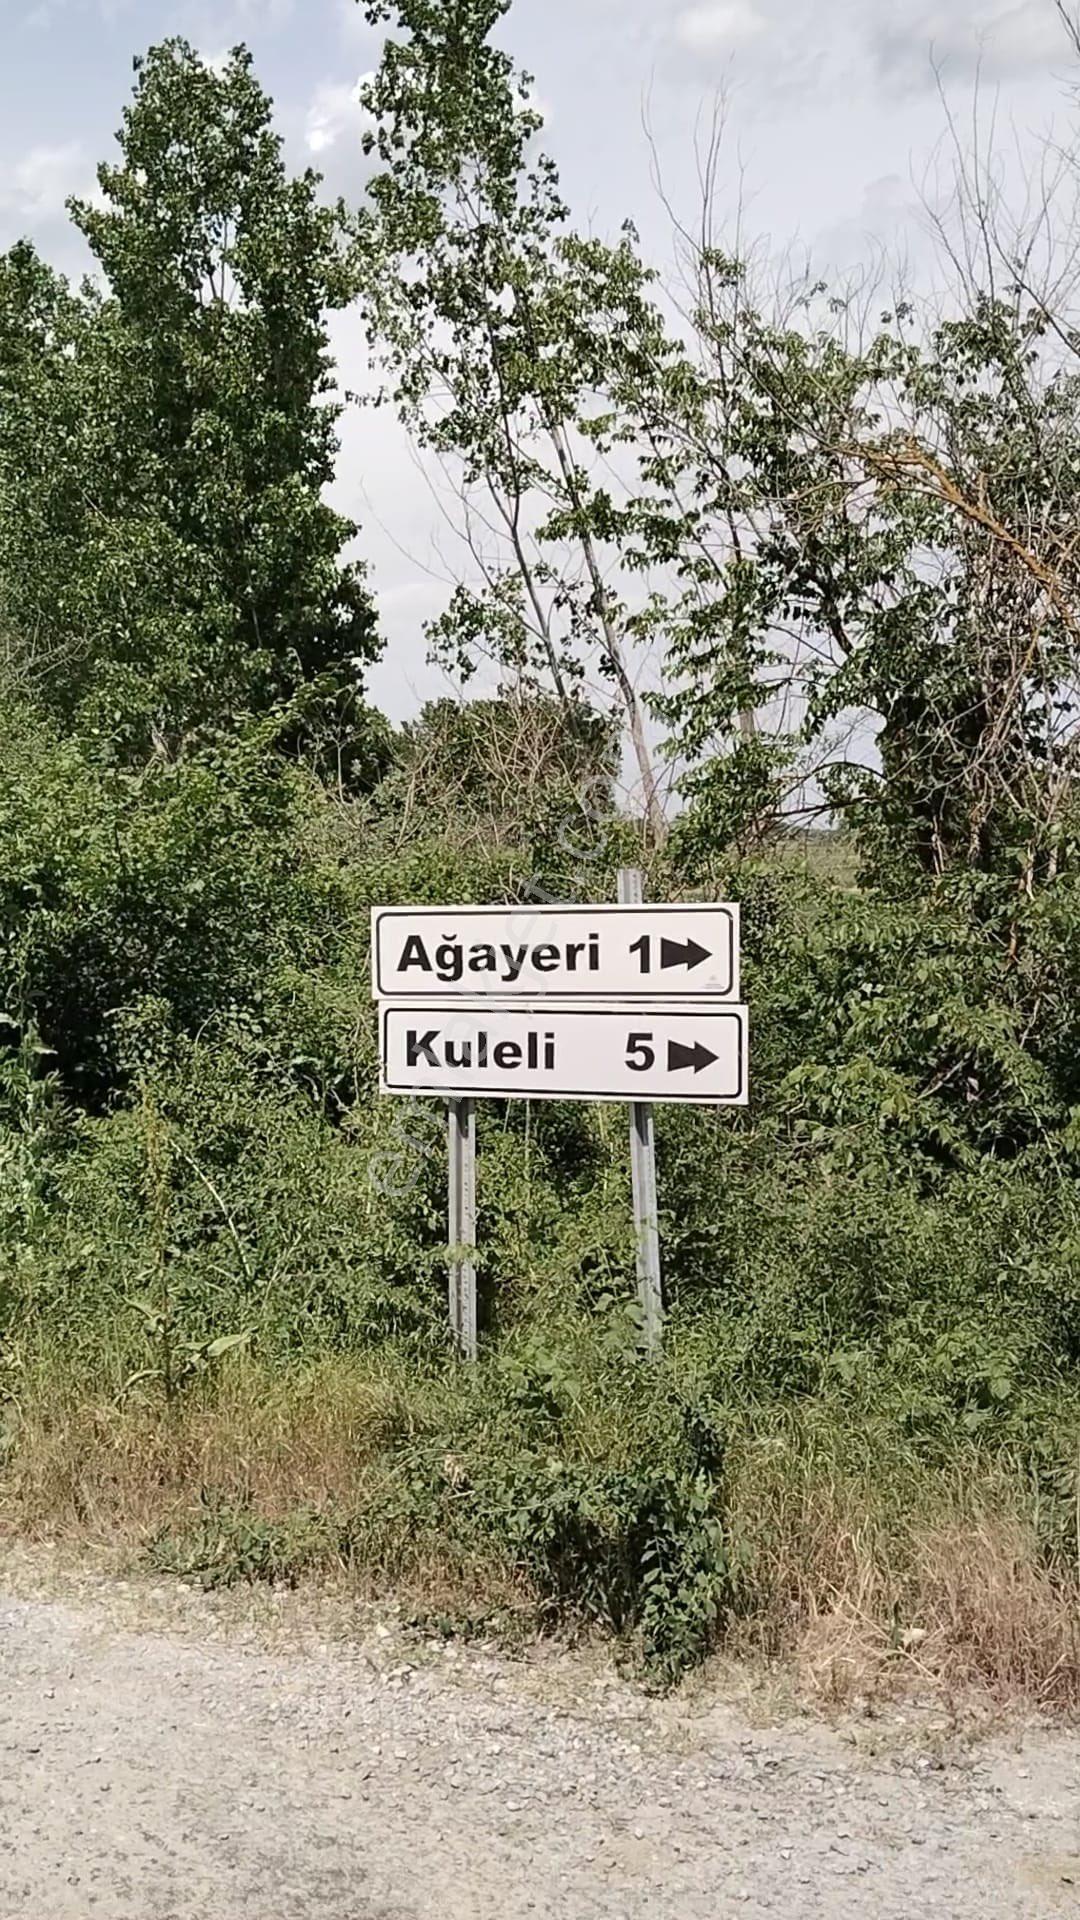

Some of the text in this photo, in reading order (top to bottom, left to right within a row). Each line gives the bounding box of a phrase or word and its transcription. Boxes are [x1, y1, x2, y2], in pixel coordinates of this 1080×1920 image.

[397, 933, 651, 982] Ağayeri 1
[406, 1030, 656, 1072] Kuleli 5
